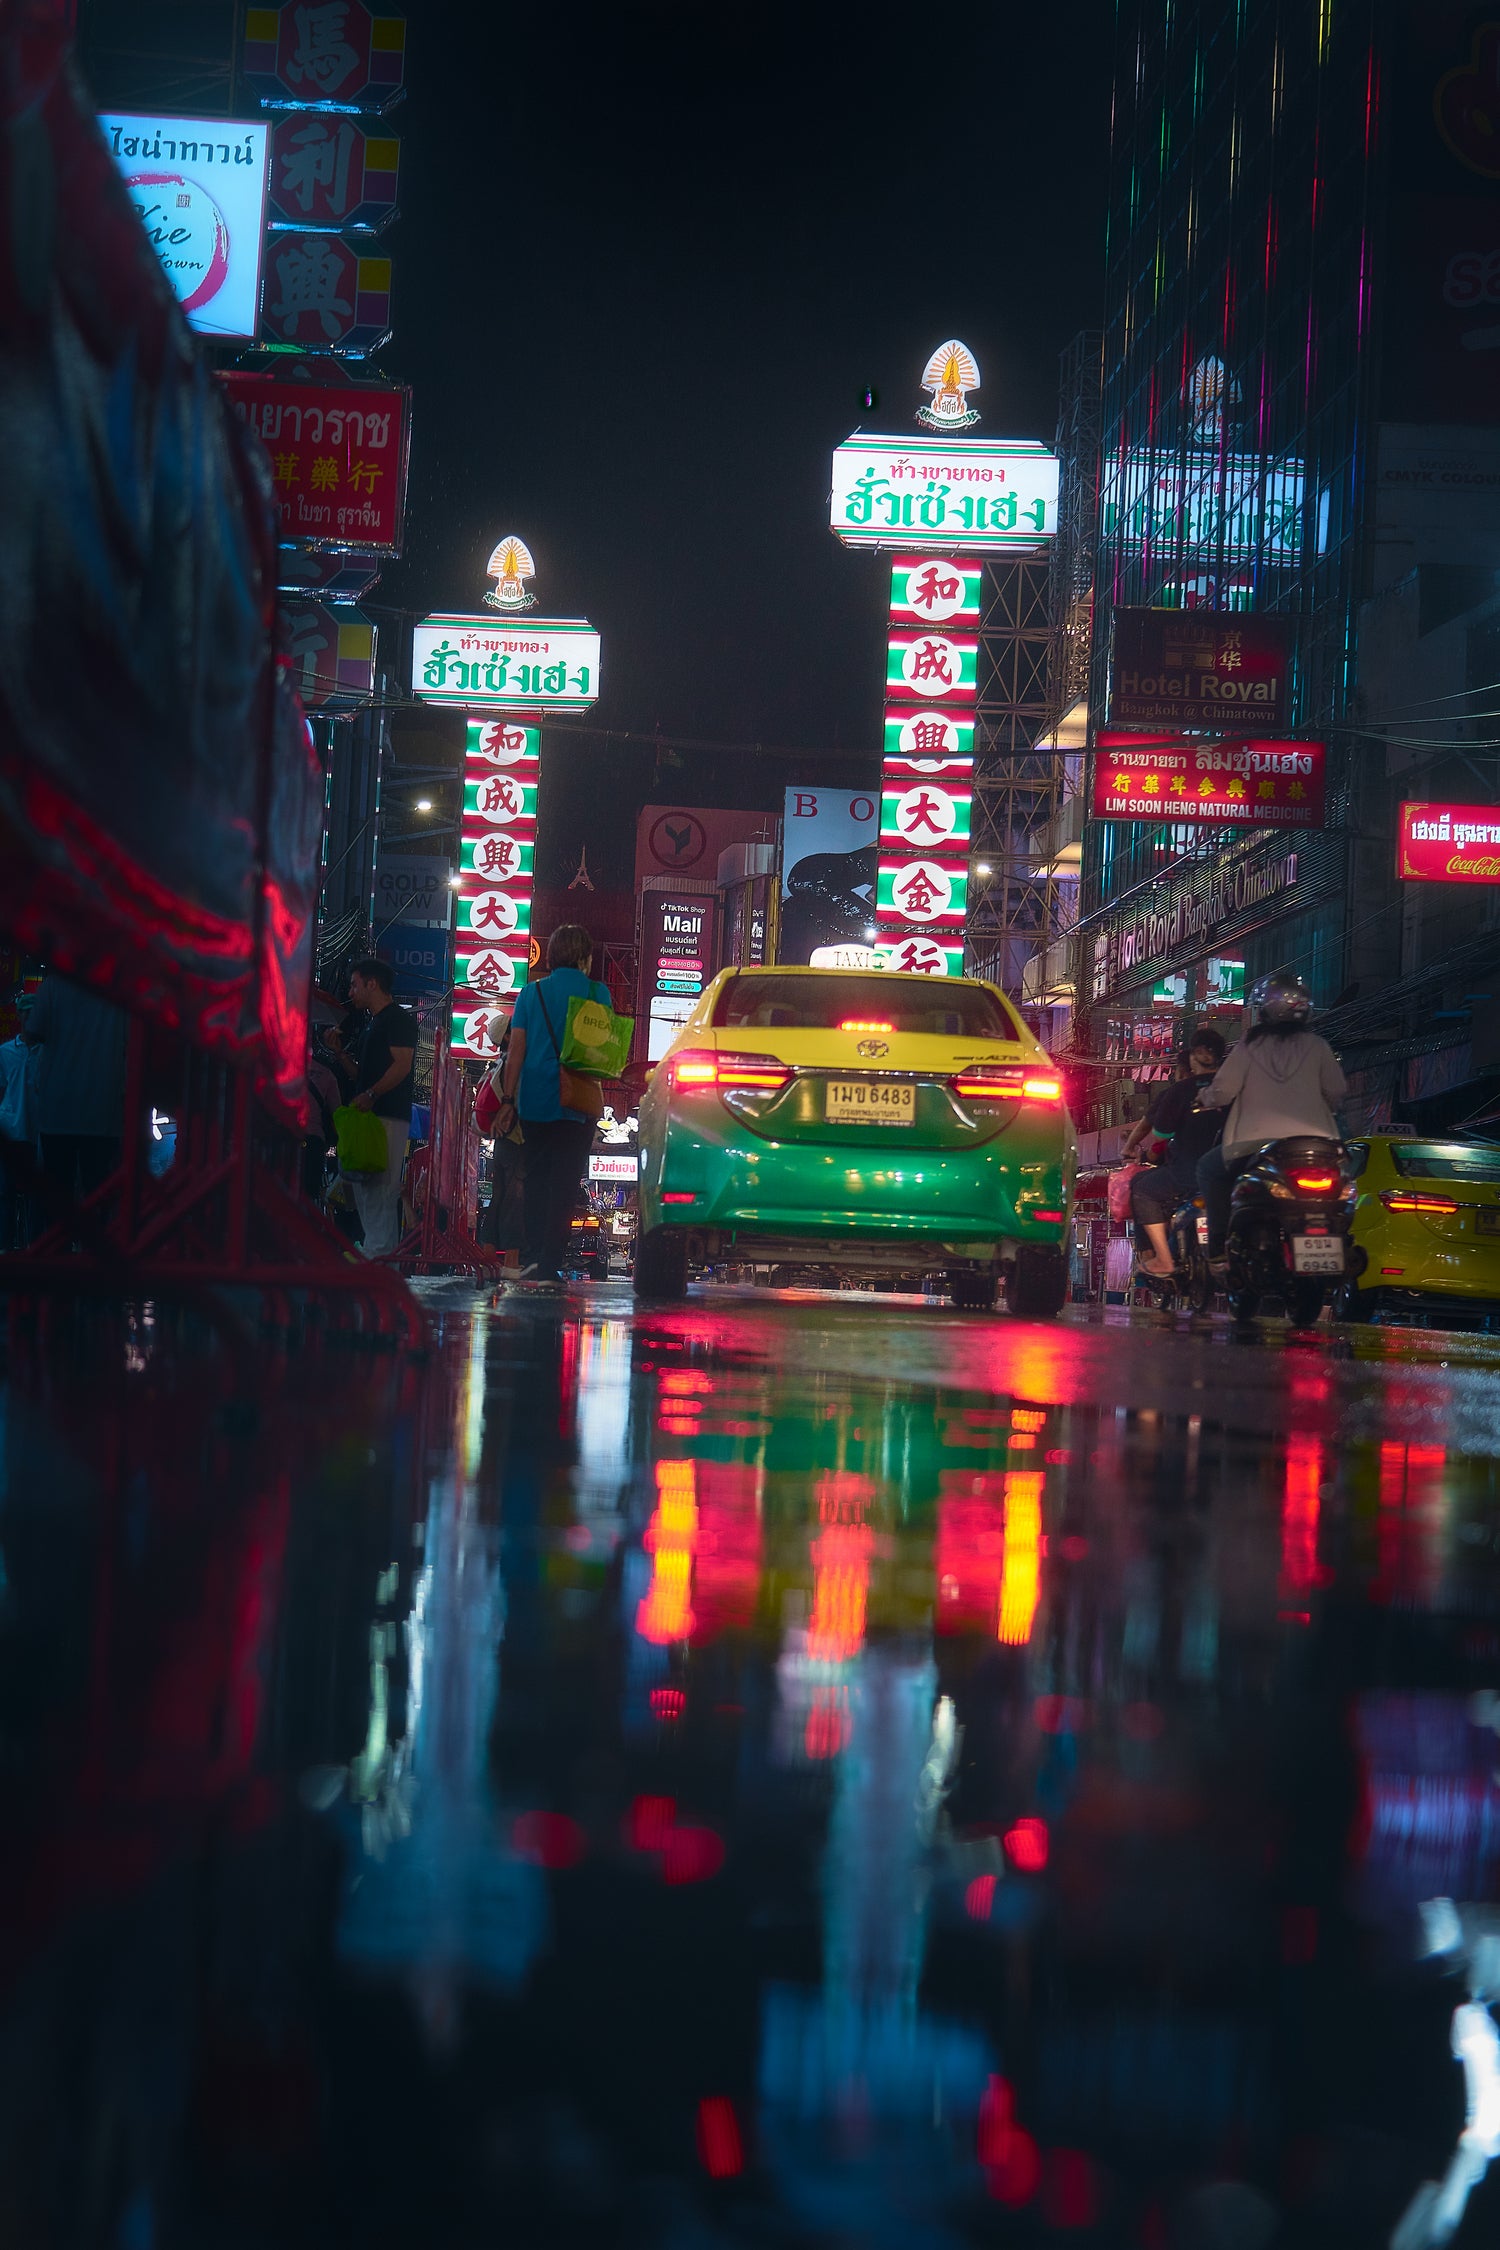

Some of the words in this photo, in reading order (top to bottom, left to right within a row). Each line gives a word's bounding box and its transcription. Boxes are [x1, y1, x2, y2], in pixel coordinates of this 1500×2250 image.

[156, 250, 204, 270] town
[890, 458, 1005, 482] ห้างขายทอง
[1441, 472, 1500, 484] COLOU
[845, 466, 1046, 532] ฮั่วเซ่งเฮง
[460, 633, 550, 654] ห้างขายทอง
[423, 640, 591, 695] ฮั่วเซ่งเฮง
[1120, 671, 1190, 697] Hotel
[1200, 675, 1277, 702] Royal
[1120, 703, 1179, 718] Bangkok
[1183, 706, 1199, 721] @
[1202, 705, 1275, 721] Chinatown
[1105, 798, 1127, 812] LIM
[1128, 799, 1162, 814] SOON
[1164, 801, 1197, 816] HENG
[1198, 803, 1253, 819] NATURAL
[1253, 805, 1312, 821] MEDICINE
[380, 873, 440, 893] GOLD
[385, 892, 432, 909] NOW
[668, 904, 689, 913] TikTok
[690, 906, 706, 915] Shop
[1117, 920, 1147, 973] Hotel
[1149, 898, 1181, 960] Royal
[1184, 873, 1226, 944] Bangkok
[1234, 853, 1298, 911] Chinatown
[663, 915, 702, 934] Mall
[394, 949, 436, 967] UOB
[834, 951, 870, 968] TAXI
[870, 1088, 911, 1105] 6483
[1378, 1125, 1411, 1135] TAXI
[1303, 1260, 1339, 1272] 6943
